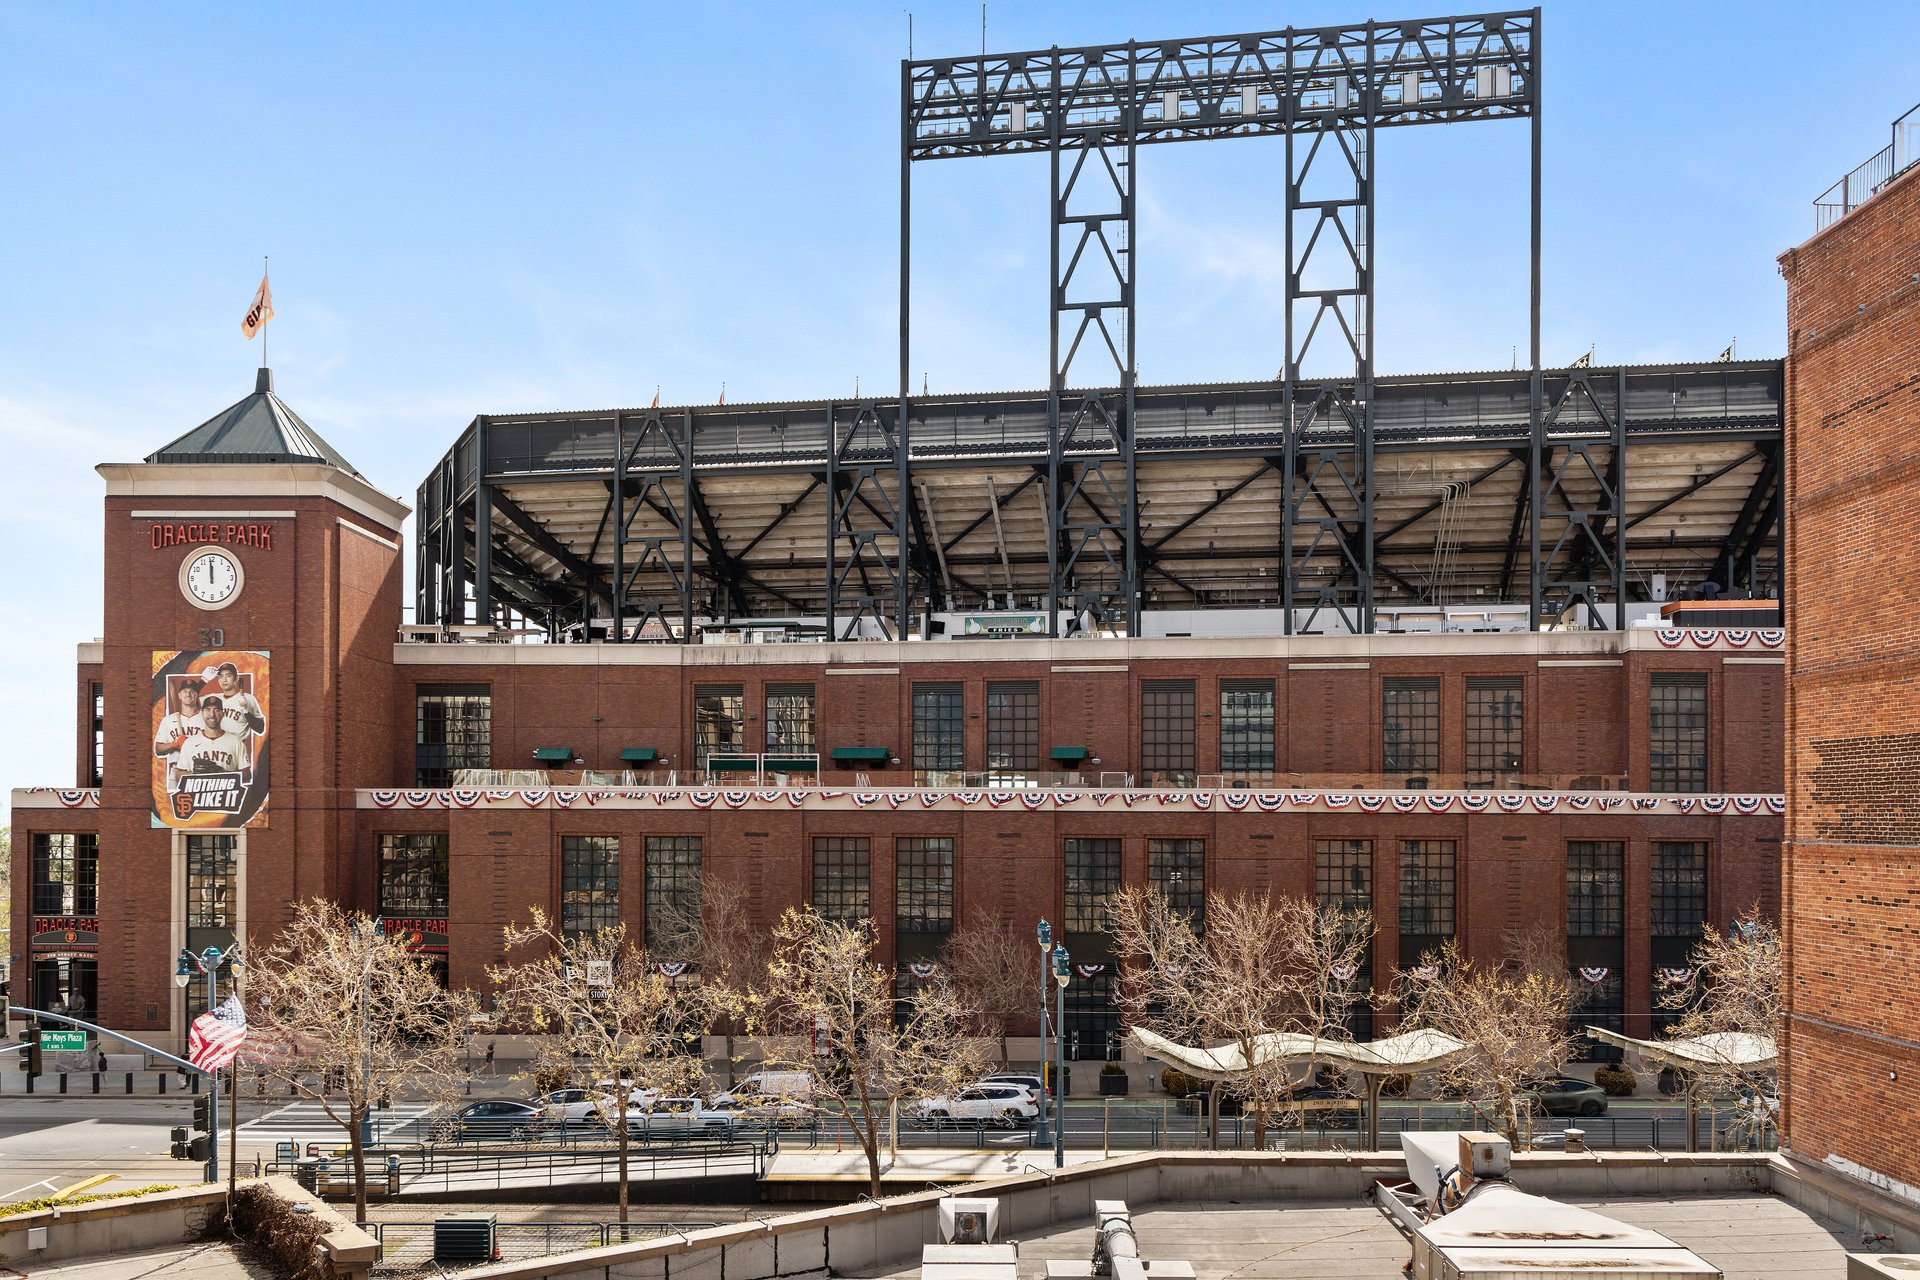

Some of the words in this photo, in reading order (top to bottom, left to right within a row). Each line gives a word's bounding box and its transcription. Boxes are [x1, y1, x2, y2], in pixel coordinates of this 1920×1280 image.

[151, 524, 220, 550] ORACLE
[225, 524, 272, 551] PARK
[198, 627, 224, 647] 30
[153, 651, 178, 671] GIANT
[184, 778, 236, 793] NOTHING
[193, 791, 224, 807] LIKE
[225, 790, 239, 807] IT
[34, 918, 76, 935] ORACLE
[80, 919, 98, 933] PAR
[425, 919, 449, 935] PAR
[41, 1033, 51, 1041] illie
[52, 1033, 66, 1043] Mays
[67, 1033, 82, 1041] Plaza
